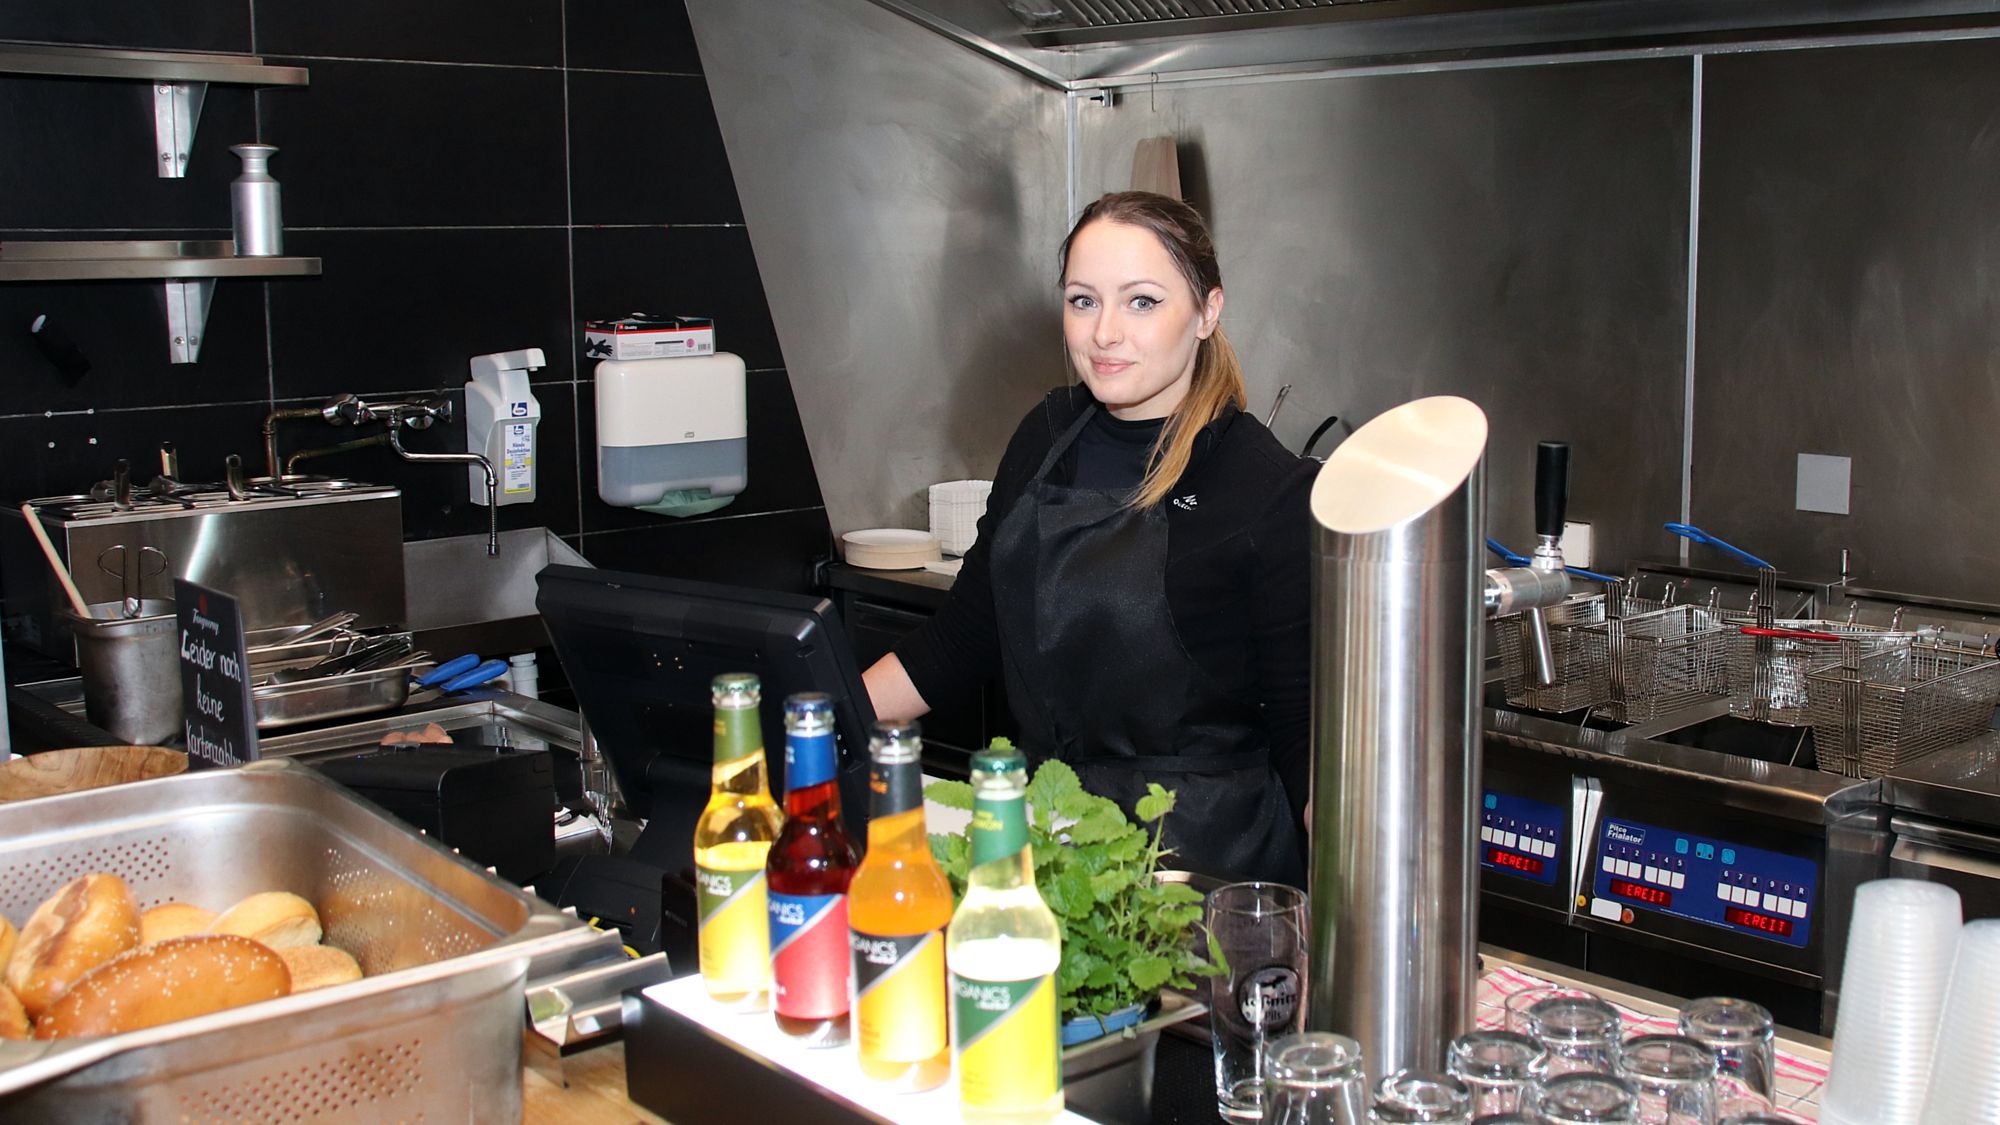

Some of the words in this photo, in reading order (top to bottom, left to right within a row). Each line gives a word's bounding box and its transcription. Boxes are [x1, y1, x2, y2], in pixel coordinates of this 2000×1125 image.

[181, 628, 217, 670] Leider
[220, 650, 241, 683] noch
[196, 673, 225, 723] keine
[1607, 830, 1642, 843] Frialator
[1609, 823, 1628, 833] Pitco
